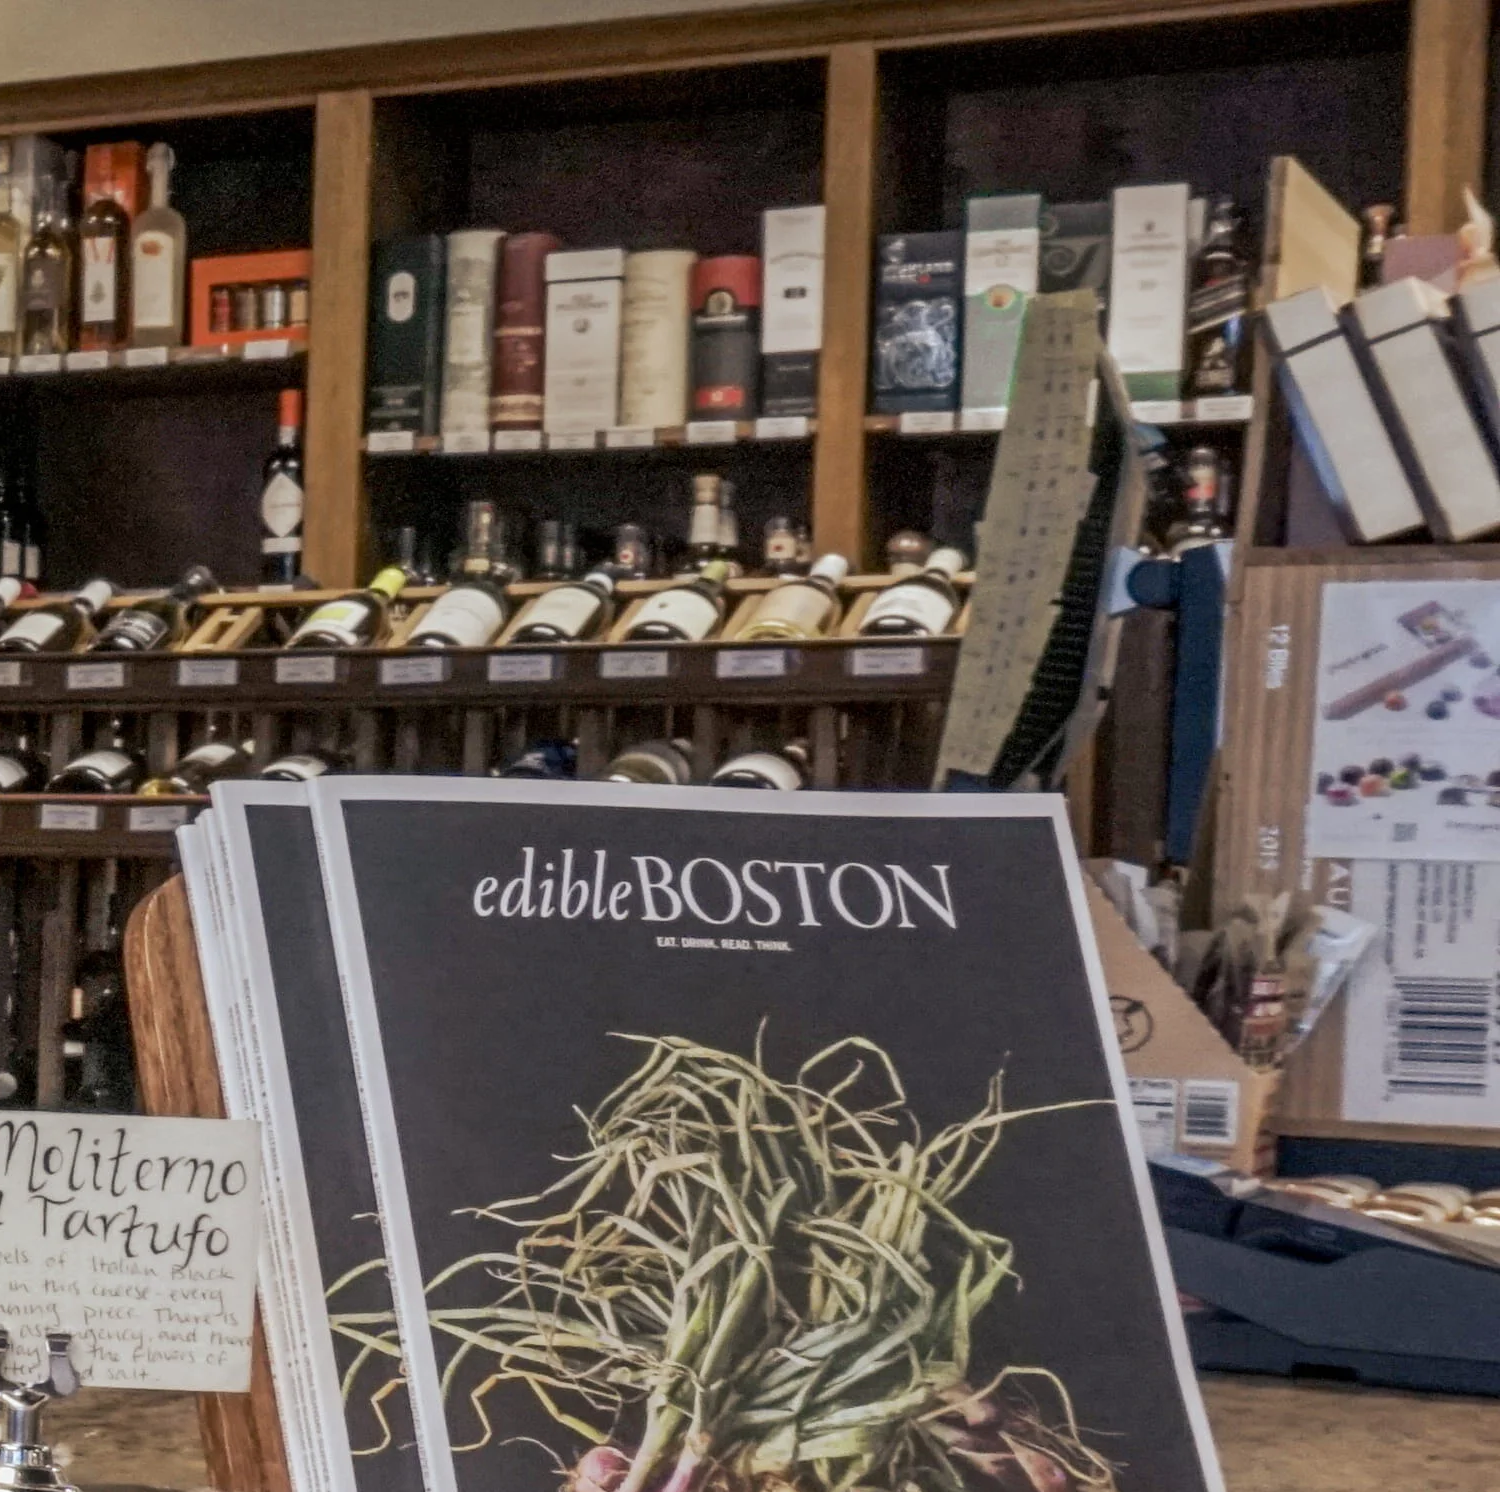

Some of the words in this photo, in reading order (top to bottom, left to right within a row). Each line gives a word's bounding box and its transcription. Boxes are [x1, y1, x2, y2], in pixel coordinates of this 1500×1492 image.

[656, 935, 679, 948] EAT.
[755, 938, 793, 953] THINK.
[28, 1194, 229, 1270] Tartufo
[92, 1256, 157, 1277] Italian
[171, 1268, 235, 1281] Black
